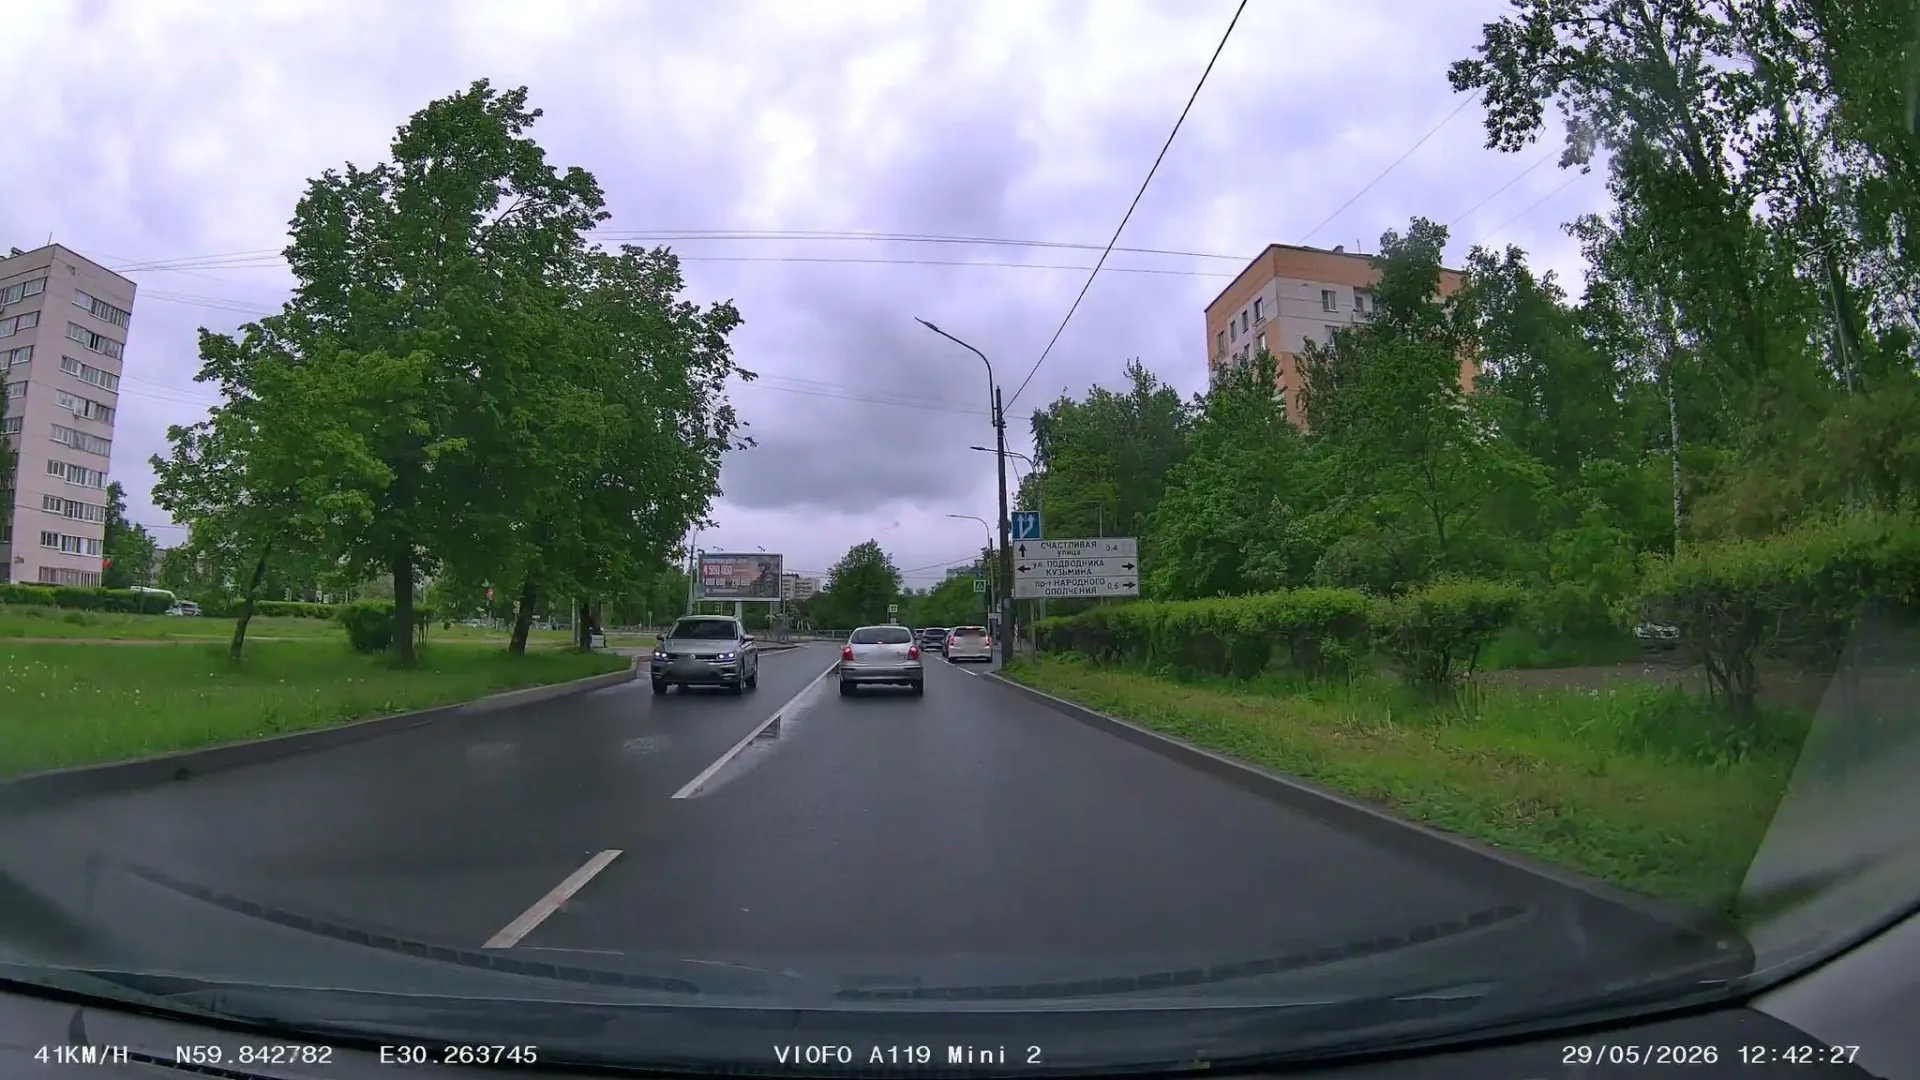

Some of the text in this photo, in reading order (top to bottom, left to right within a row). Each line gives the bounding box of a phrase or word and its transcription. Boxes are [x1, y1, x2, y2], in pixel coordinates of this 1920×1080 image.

[1040, 541, 1097, 549] СЧАСТЛИВАЯ
[1057, 549, 1081, 557] улица
[1046, 560, 1104, 568] ПОДВОДНИКА
[1046, 568, 1092, 576] КУЗЬМИНА
[1035, 578, 1106, 588] пр-т НАРОДНОГО
[1045, 587, 1097, 595] ОПОЛЧЕНИЯ
